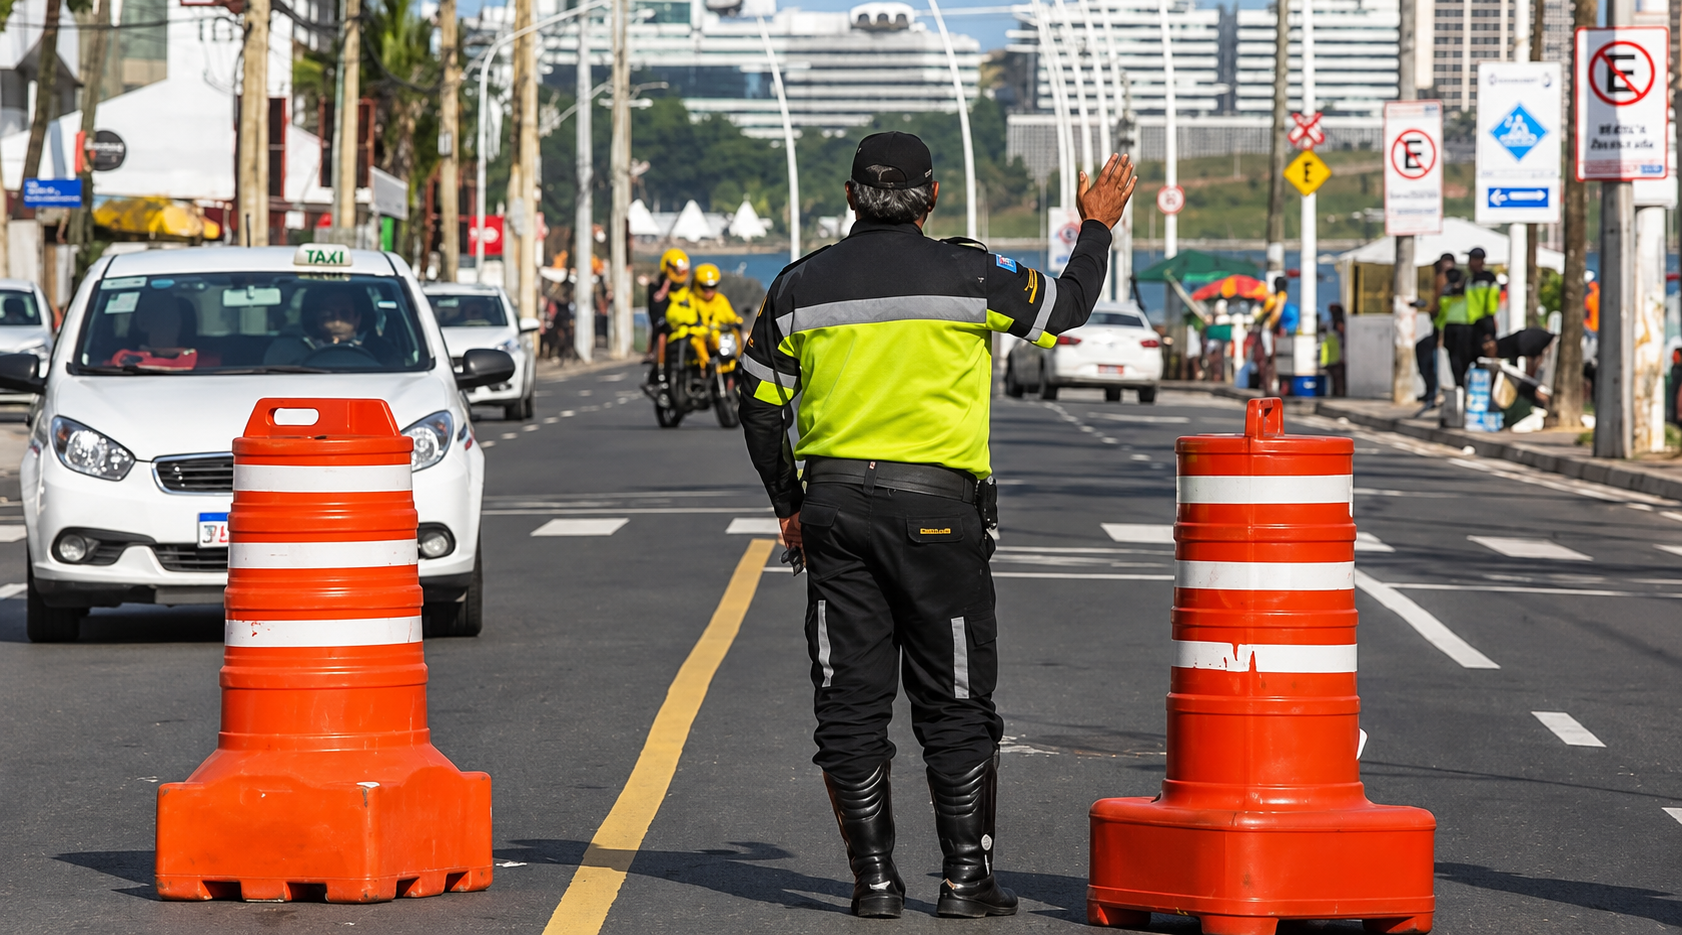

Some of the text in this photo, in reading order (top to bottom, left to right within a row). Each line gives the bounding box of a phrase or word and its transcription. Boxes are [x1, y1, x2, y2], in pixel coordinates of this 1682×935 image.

[1607, 54, 1635, 93] E
[1405, 140, 1421, 168] E
[305, 249, 343, 264] TAXI
